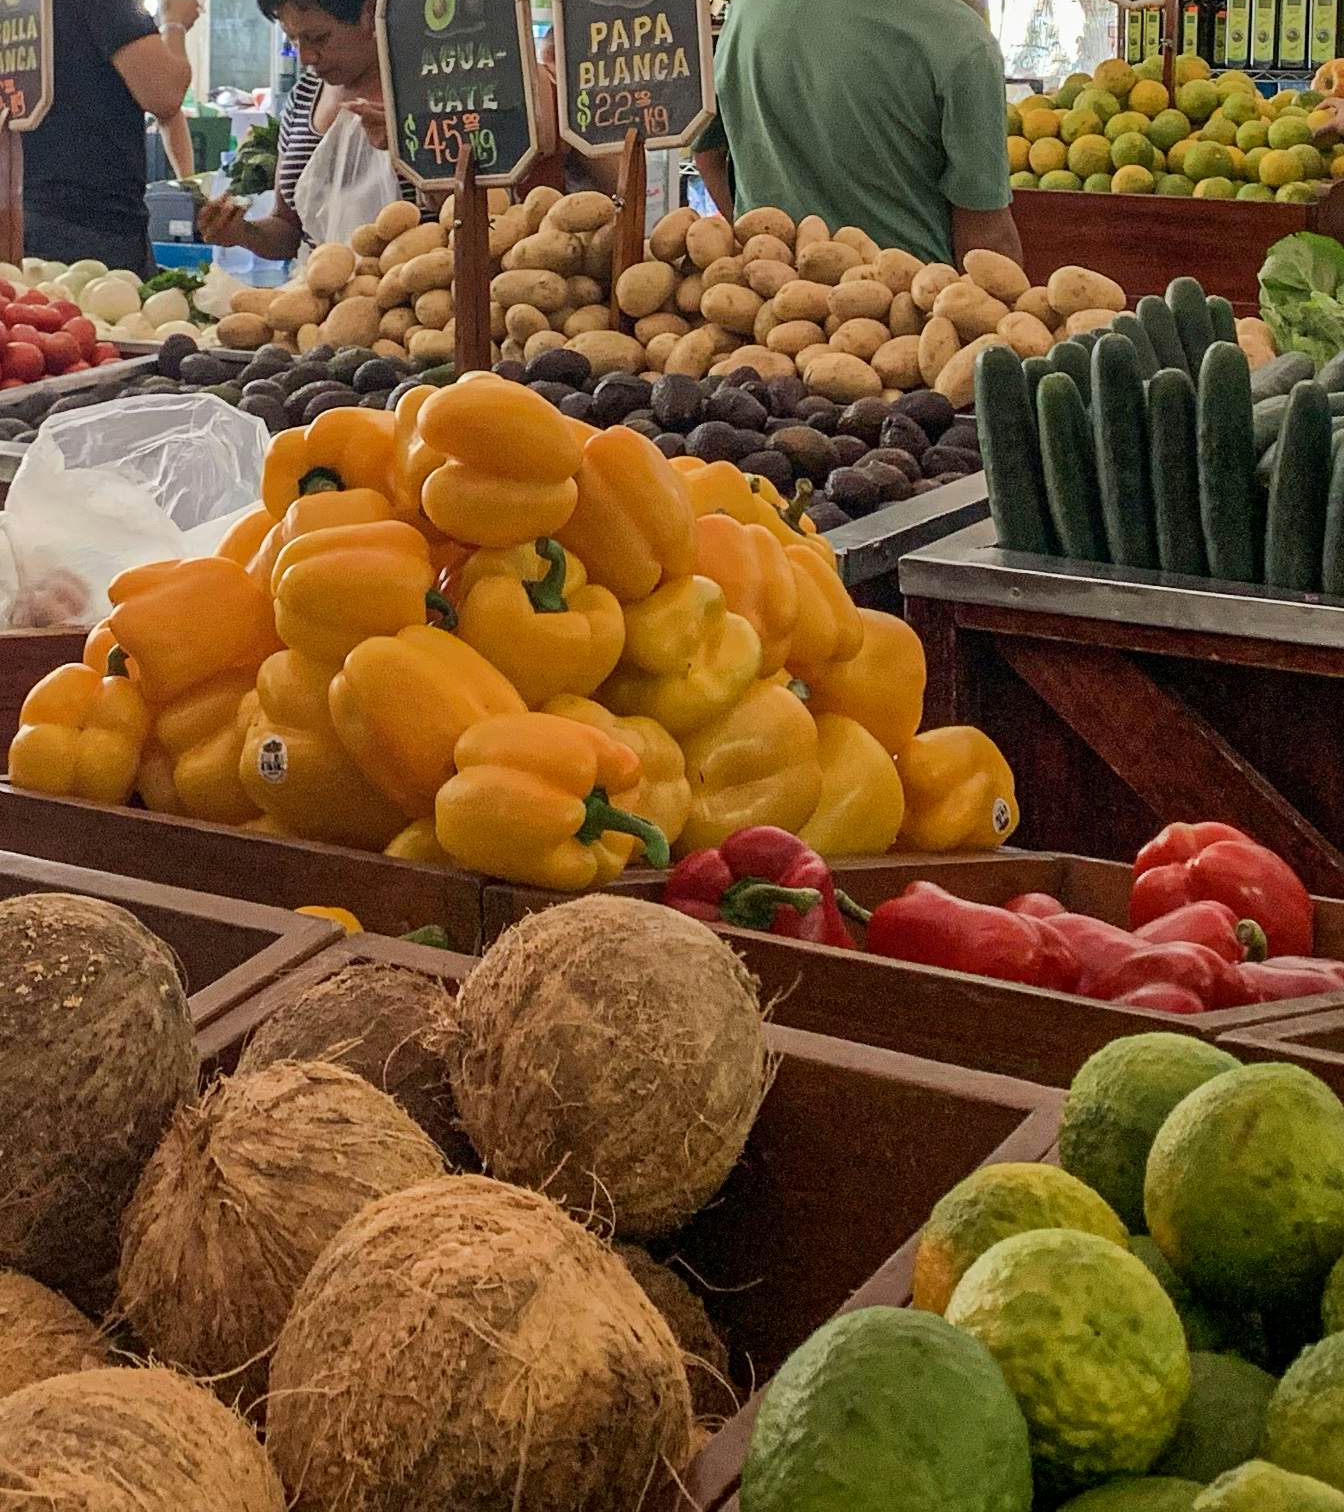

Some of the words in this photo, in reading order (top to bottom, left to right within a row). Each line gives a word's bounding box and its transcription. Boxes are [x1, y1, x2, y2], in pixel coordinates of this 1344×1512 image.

[590, 13, 674, 53] PAPA
[578, 47, 691, 89] BLANCA
[428, 83, 498, 113] CATE
